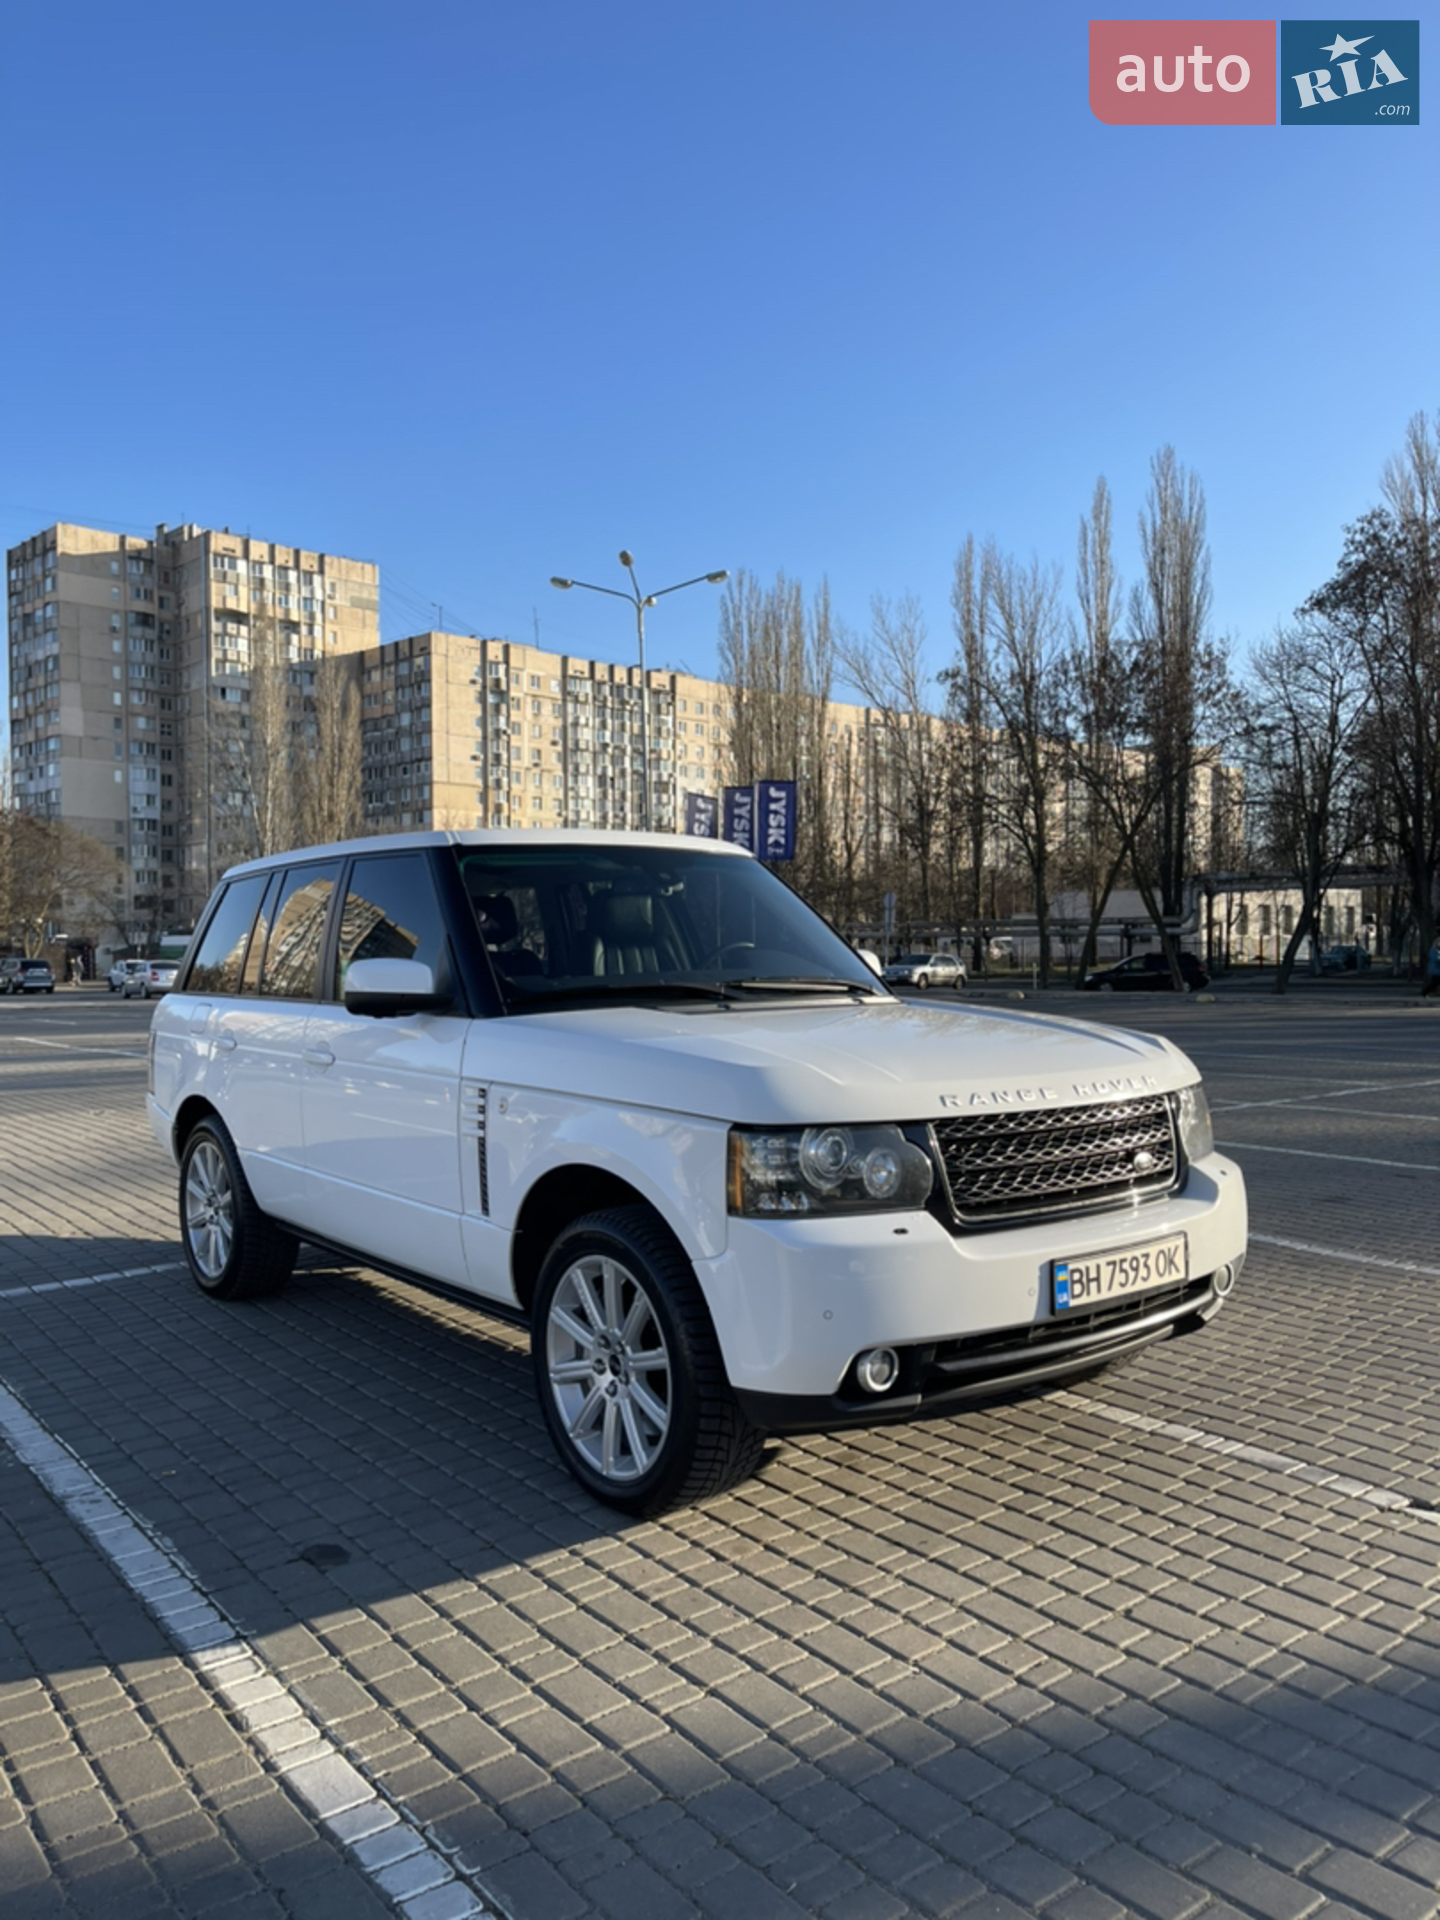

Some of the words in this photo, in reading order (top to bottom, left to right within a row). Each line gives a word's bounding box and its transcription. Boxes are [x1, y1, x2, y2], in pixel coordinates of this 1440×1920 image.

[693, 798, 713, 837] JYS
[732, 792, 751, 848] JYSK
[768, 786, 787, 846] JYSK
[939, 1087, 1059, 1108] RANGE
[1072, 1075, 1158, 1097] ROVER
[1070, 1263, 1102, 1300] BH
[1106, 1252, 1151, 1292] 7593
[1155, 1245, 1180, 1279] OK
